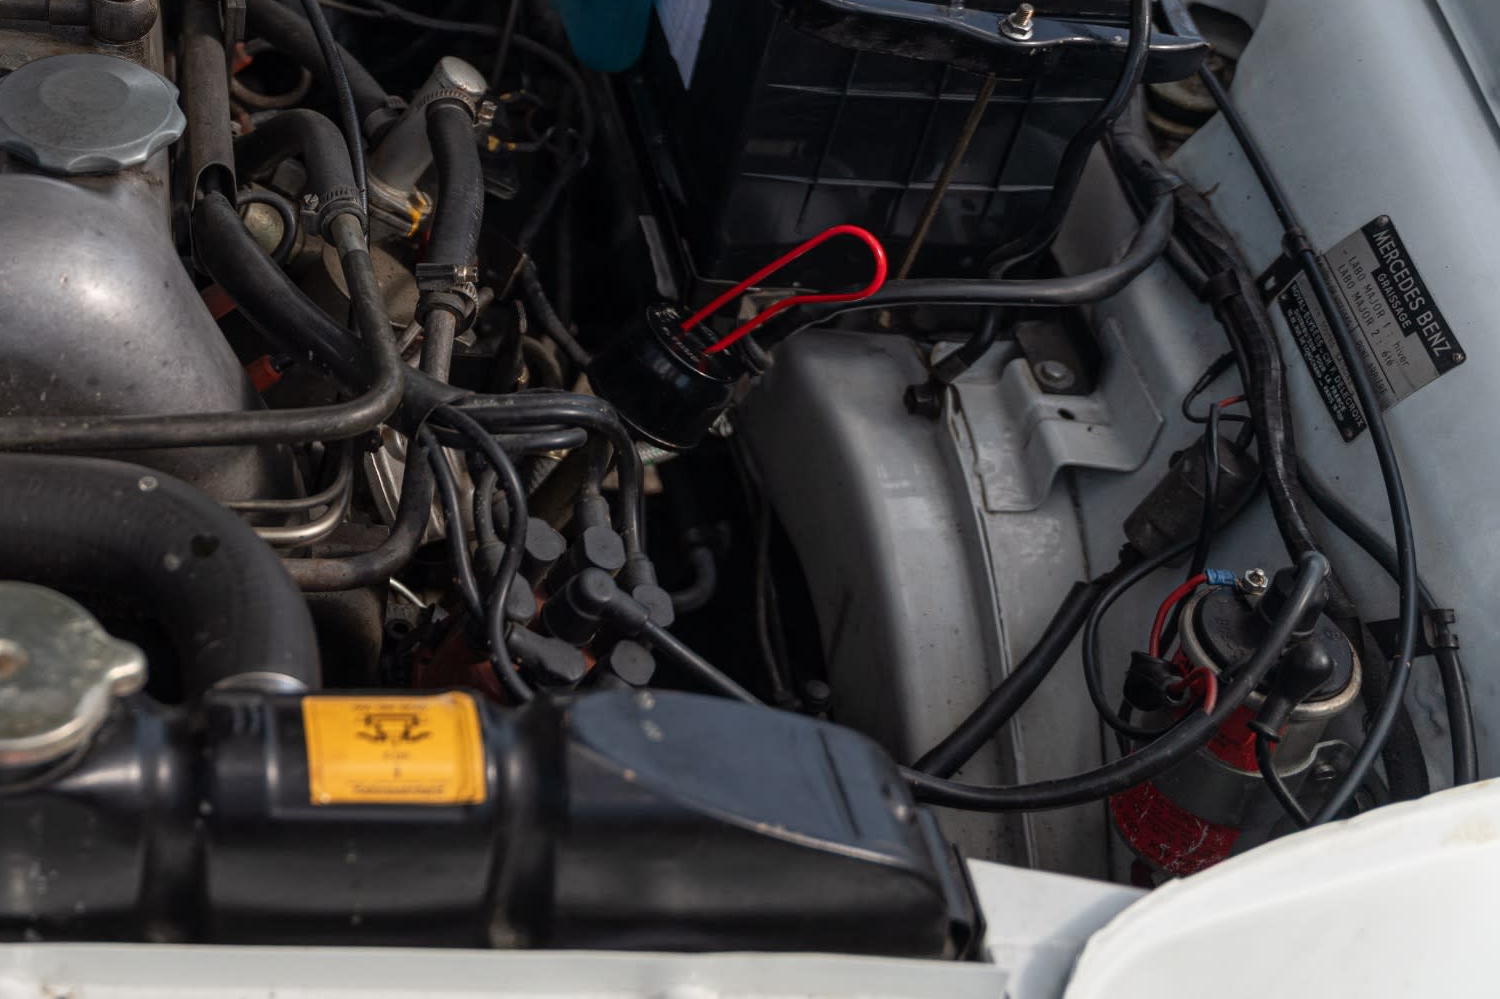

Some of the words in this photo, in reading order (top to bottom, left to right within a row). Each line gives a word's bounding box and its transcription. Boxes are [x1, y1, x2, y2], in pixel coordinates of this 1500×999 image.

[1335, 263, 1356, 290] LABO
[1350, 291, 1375, 327] MAJOR
[1380, 348, 1396, 367] été
[1347, 255, 1367, 281] LABO
[1361, 283, 1387, 318] MAJOR
[1390, 340, 1411, 367] hiver
[1369, 227, 1428, 312] MERCEDES
[1414, 309, 1452, 357] BENZ
[1374, 271, 1413, 329] GRAISSAGE
[1313, 353, 1328, 373] POUR
[1332, 375, 1366, 428] DELECROIX
